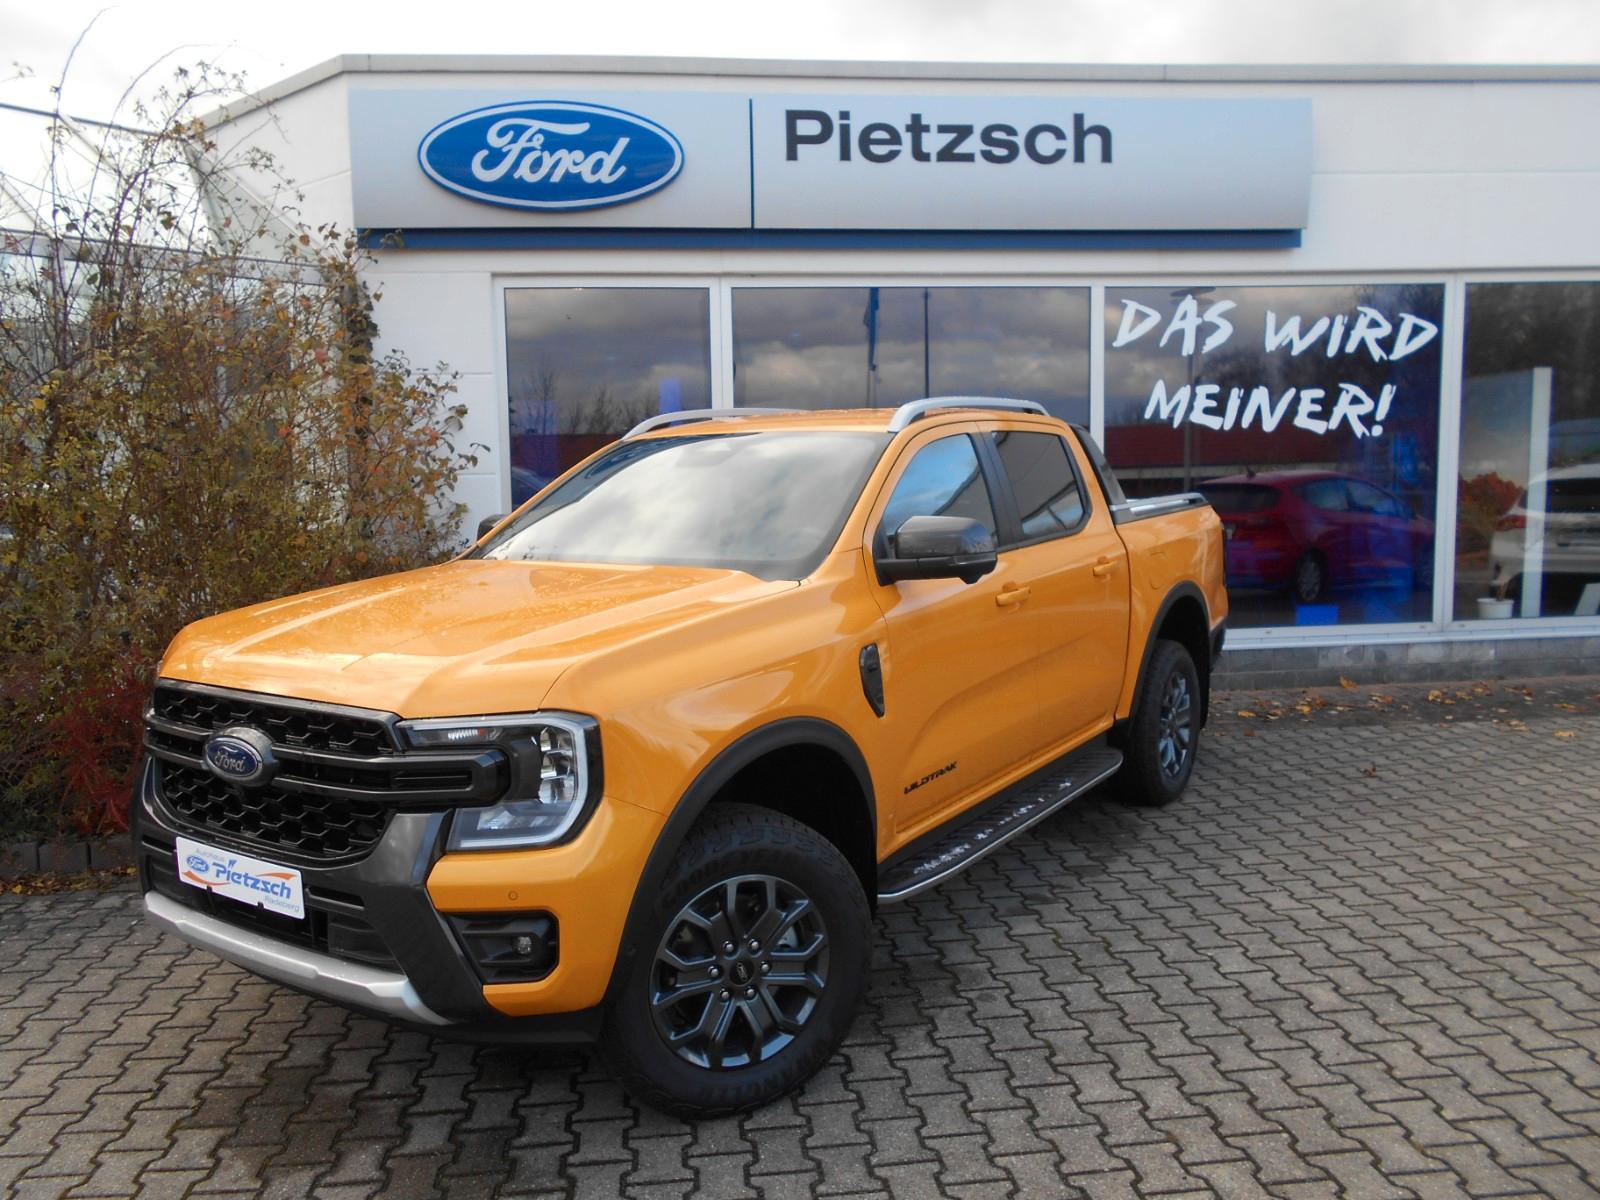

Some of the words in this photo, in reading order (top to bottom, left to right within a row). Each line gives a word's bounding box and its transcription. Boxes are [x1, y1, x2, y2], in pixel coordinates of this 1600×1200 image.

[470, 118, 630, 183] Ford
[785, 109, 1113, 164] Pietzsch
[1112, 294, 1237, 357] DAS
[1265, 306, 1438, 362] WIRD
[1144, 380, 1397, 439] MEINER!
[214, 745, 245, 772] Ford
[212, 859, 292, 899] Pietzsch
